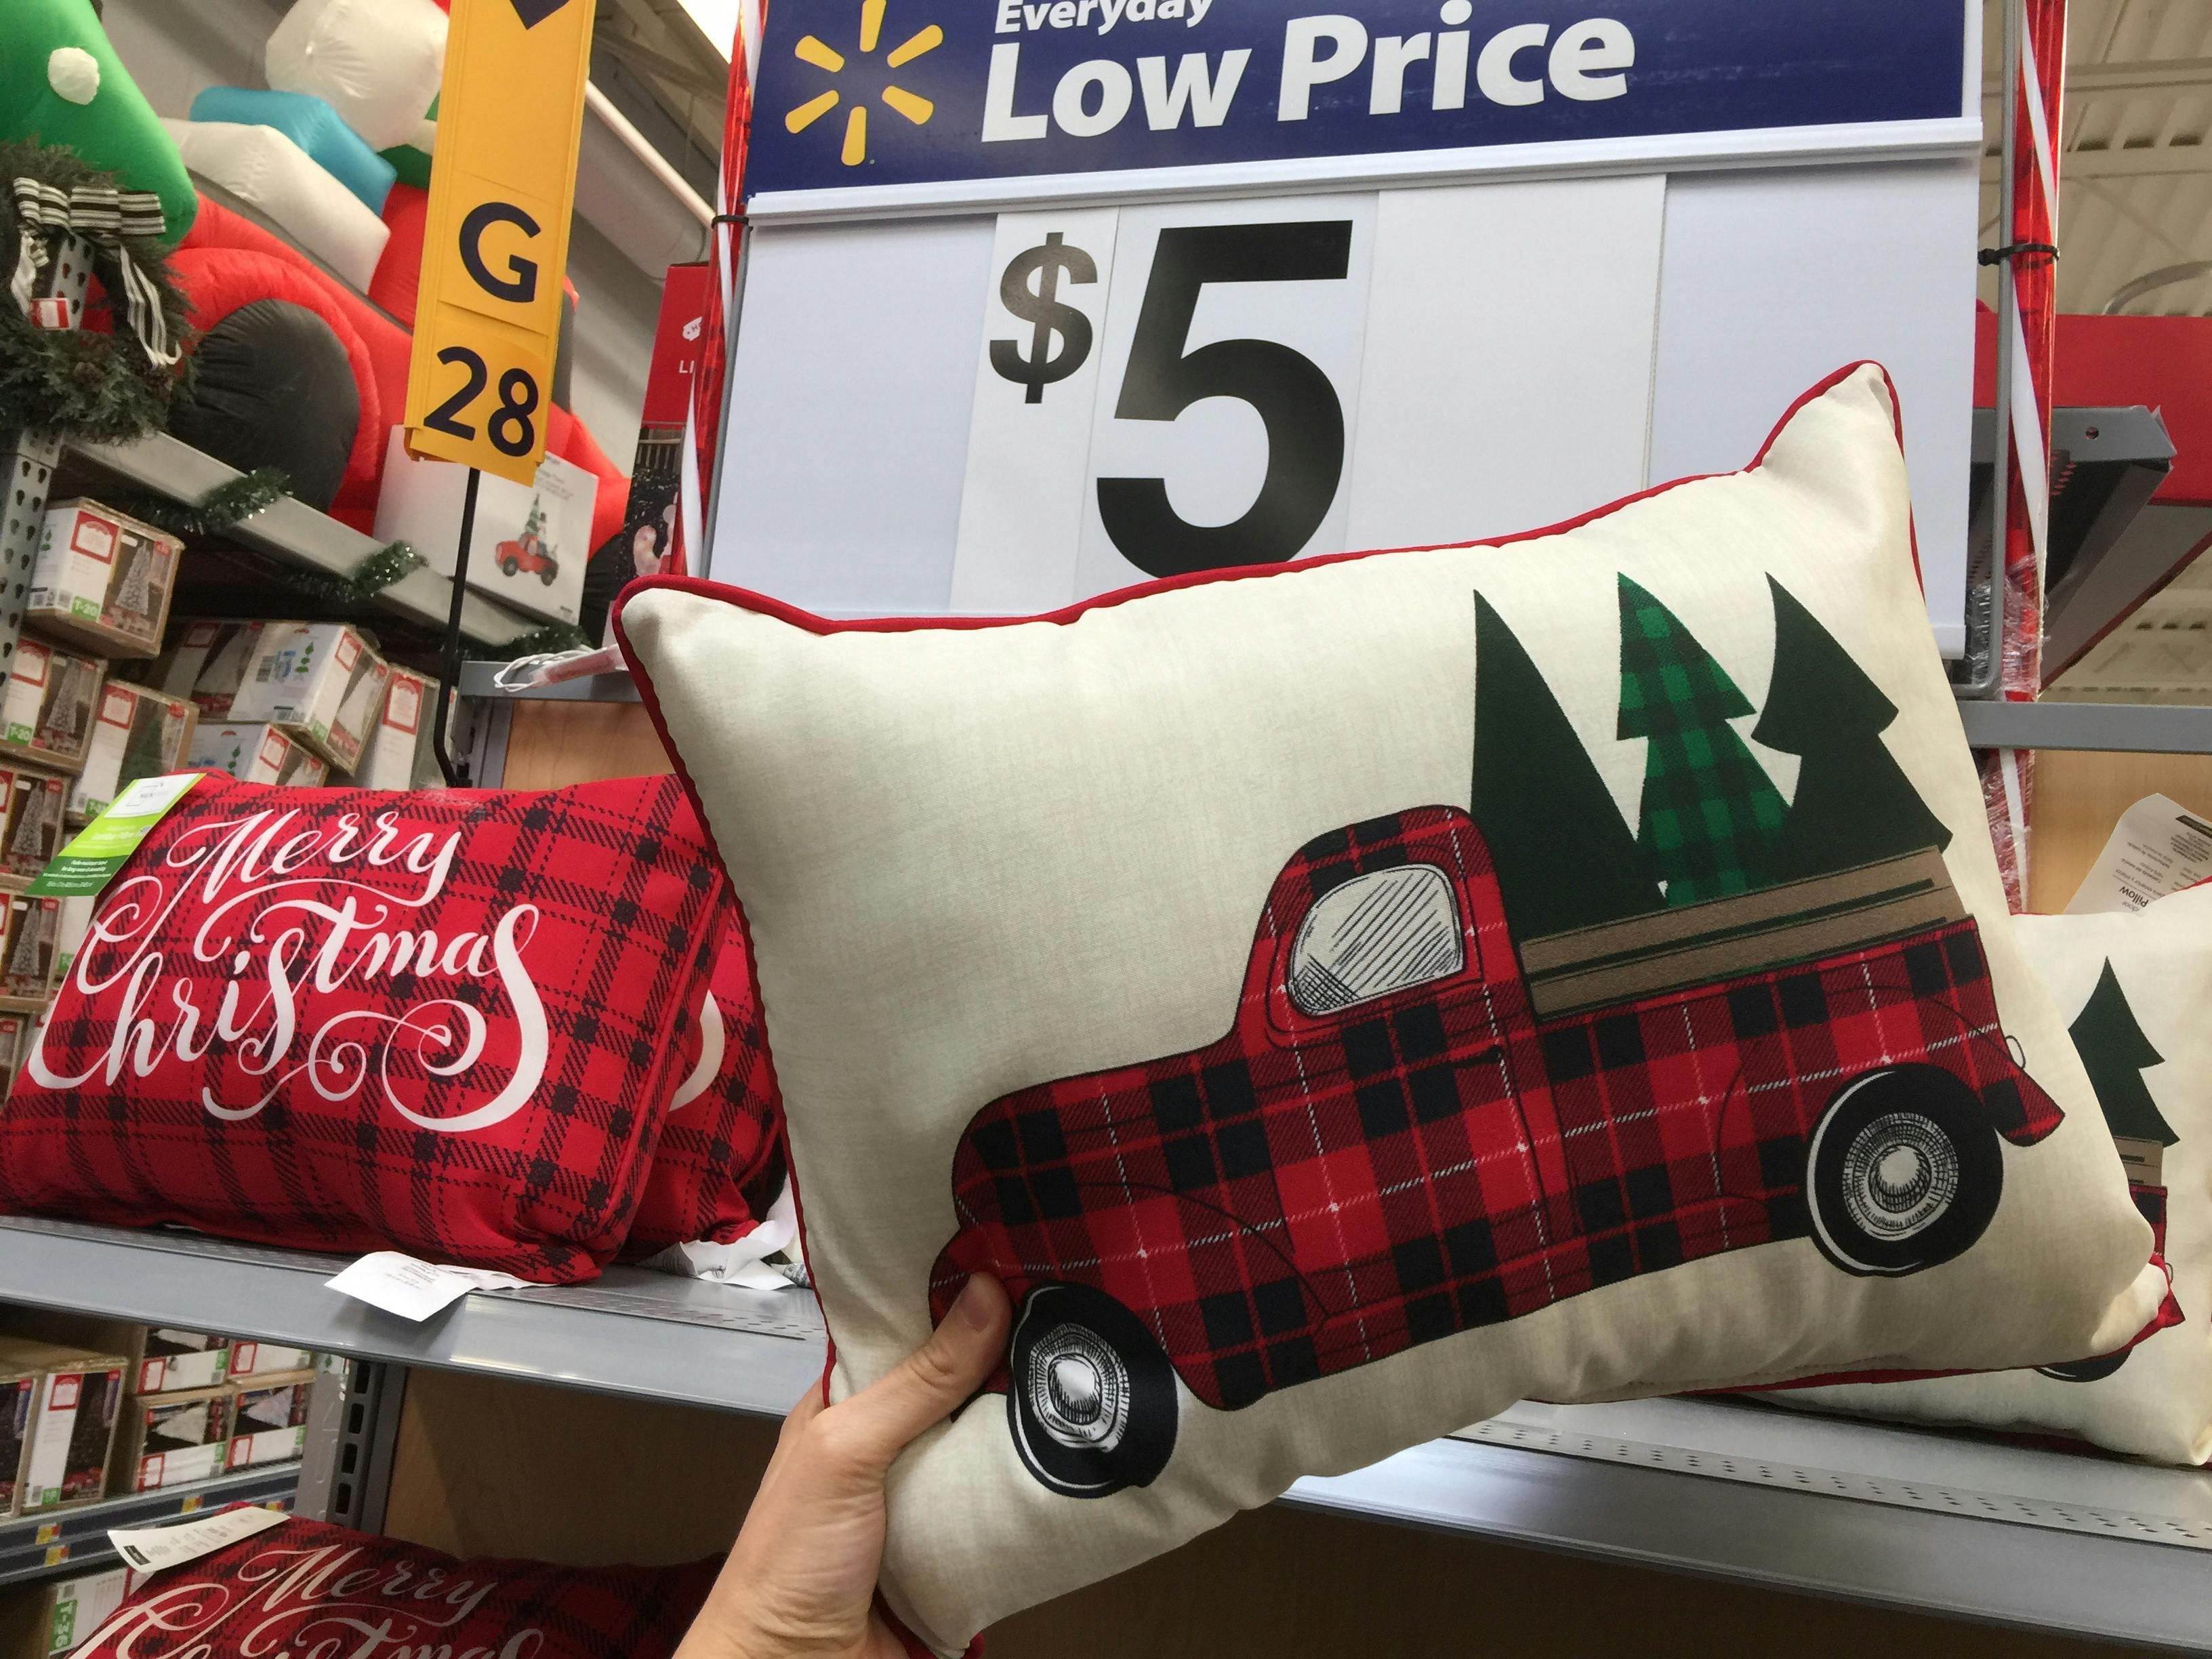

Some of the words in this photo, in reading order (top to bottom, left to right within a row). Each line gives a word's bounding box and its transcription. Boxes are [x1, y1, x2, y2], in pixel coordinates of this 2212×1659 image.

[982, 43, 1252, 142] Low
[1277, 0, 1635, 121] Price
[459, 202, 541, 303] G
[424, 346, 539, 457] 28
[989, 220, 1353, 578] $5
[167, 808, 462, 907] Merry
[2119, 886, 2149, 908] Pillow
[239, 1544, 498, 1627] Merry
